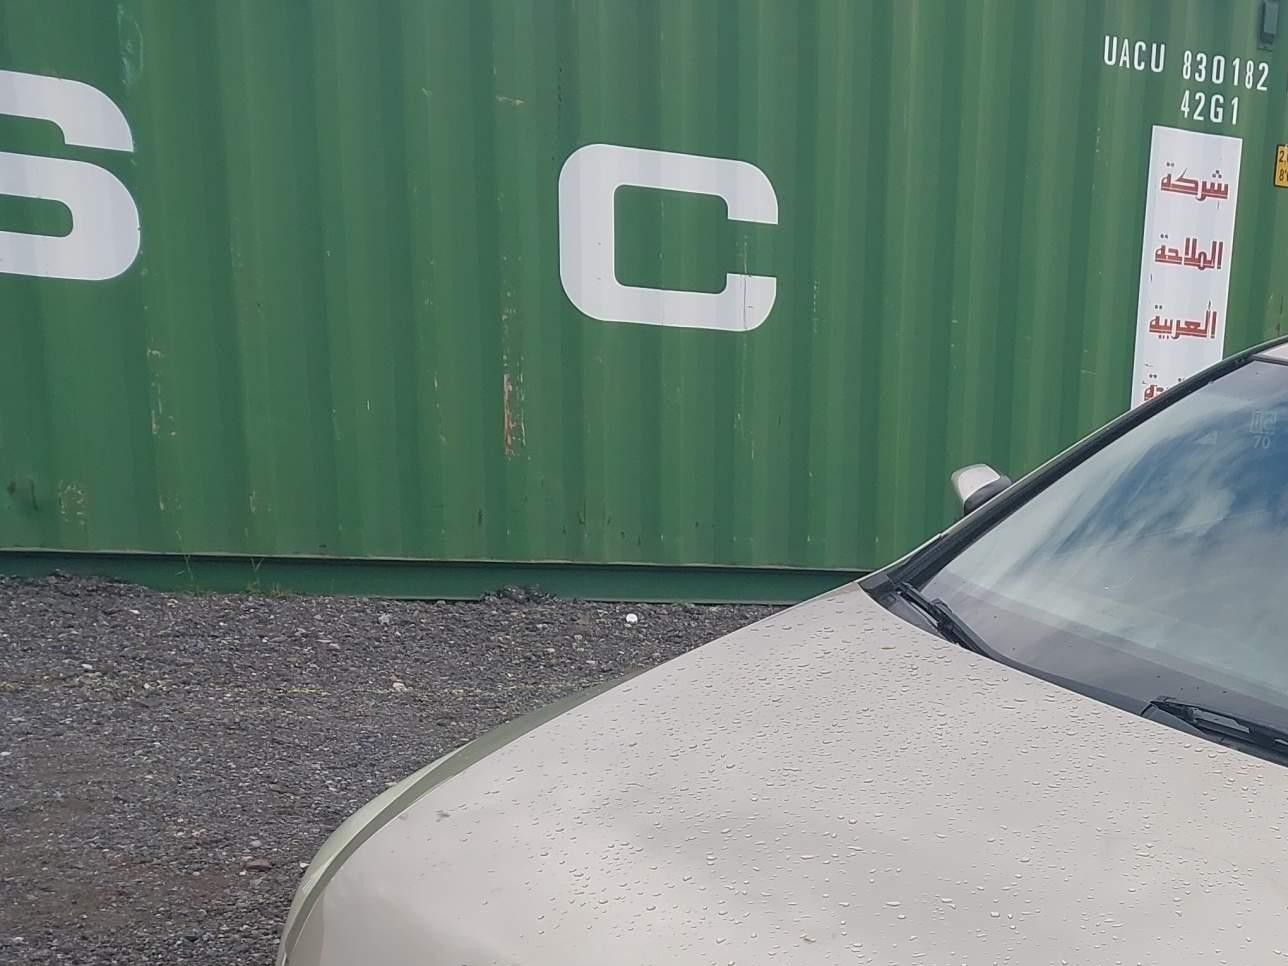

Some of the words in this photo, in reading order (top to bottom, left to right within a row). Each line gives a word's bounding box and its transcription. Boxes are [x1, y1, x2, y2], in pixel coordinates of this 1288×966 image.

[1103, 35, 1166, 73] UACU
[1182, 50, 1269, 91] 830182
[1180, 90, 1239, 125] 42G1
[1160, 162, 1229, 202] شركة
[1154, 233, 1224, 271] الملاحة
[1148, 304, 1218, 340] العربية
